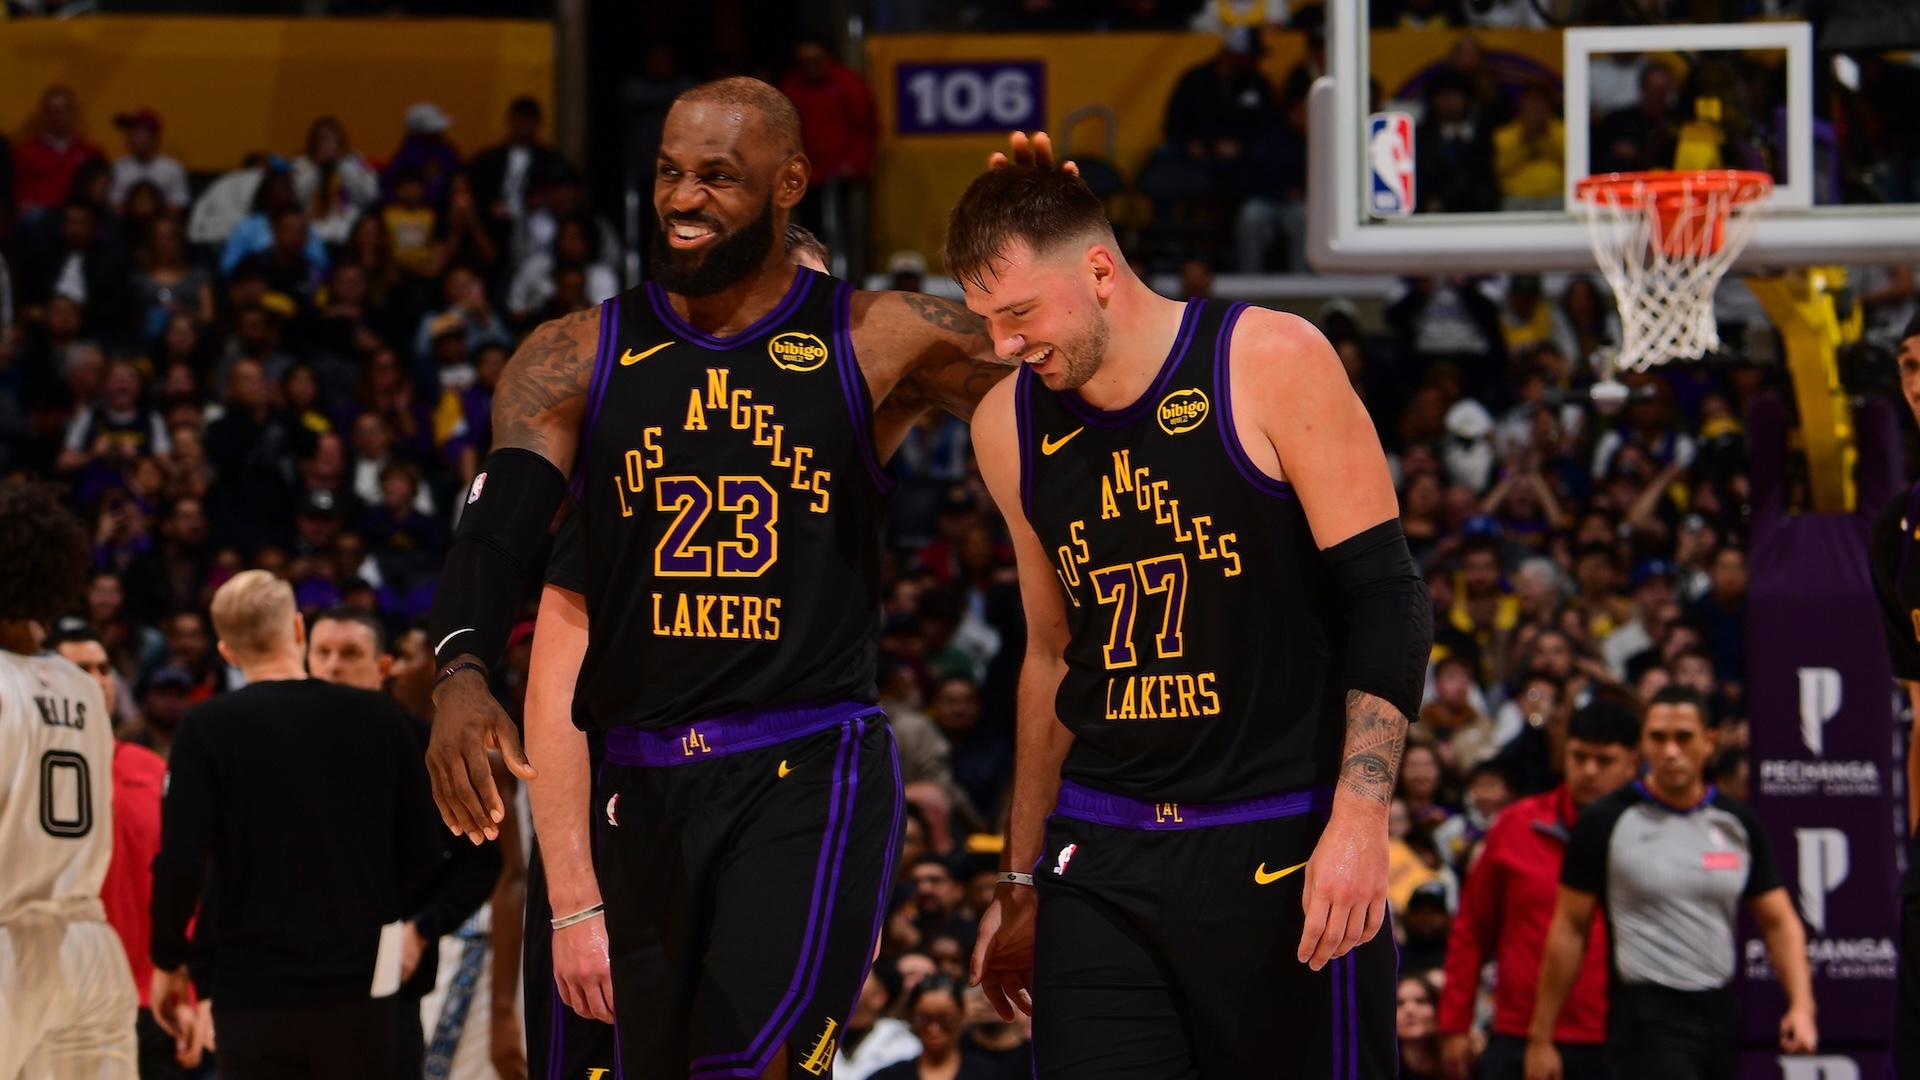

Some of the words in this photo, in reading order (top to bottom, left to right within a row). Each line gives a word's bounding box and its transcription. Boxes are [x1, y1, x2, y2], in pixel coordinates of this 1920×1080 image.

[906, 70, 1032, 125] 106
[774, 341, 824, 360] bibigo
[1162, 401, 1206, 418] bibigo
[614, 426, 664, 517] LOS
[683, 368, 831, 513] ANGELES
[654, 475, 778, 577] 23
[1101, 449, 1242, 577] ANGELES
[652, 593, 781, 640] LAKERS
[1089, 553, 1188, 669] 77
[1105, 672, 1220, 720] LAKERS
[682, 727, 711, 756] LAL
[39, 749, 93, 837] 0
[1155, 803, 1183, 823] LAL
